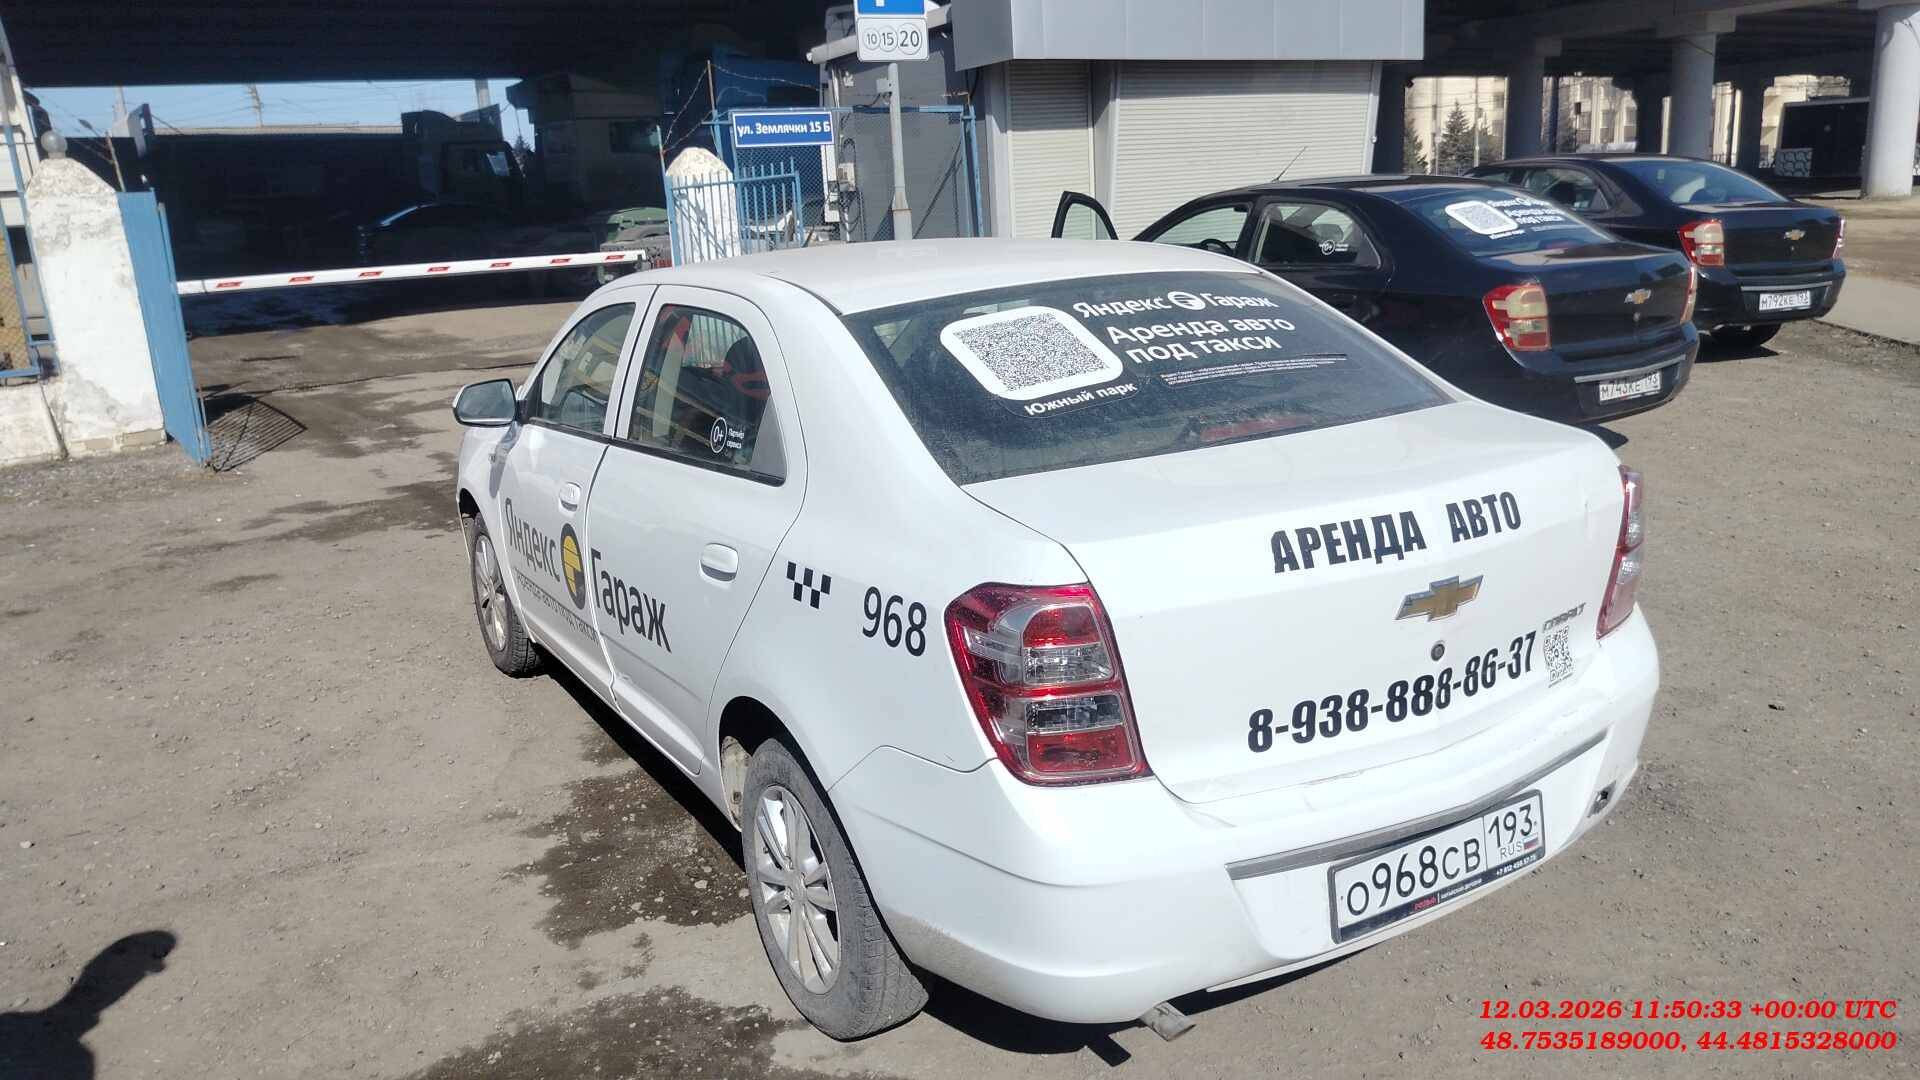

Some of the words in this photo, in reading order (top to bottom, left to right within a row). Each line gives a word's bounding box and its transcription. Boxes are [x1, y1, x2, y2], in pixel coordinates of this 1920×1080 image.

[866, 33, 877, 45] 10
[881, 32, 895, 46] 15
[900, 30, 920, 47] 20
[737, 125, 754, 138] ул.
[755, 122, 808, 134] Землячки
[809, 120, 822, 133] 15
[823, 121, 831, 132] Б
[1072, 296, 1172, 318] Яндекс
[1200, 293, 1280, 309] Гараж
[1106, 320, 1229, 345] Аренда
[1228, 318, 1296, 331] авто
[1125, 343, 1198, 363] под
[1190, 335, 1282, 354] такси
[1024, 390, 1095, 416] Южный
[1093, 382, 1138, 400] парк
[1270, 510, 1427, 574] АРЕНДА
[1445, 491, 1522, 543] АВТО
[505, 497, 561, 582] Яндекс
[591, 547, 672, 654] Гараж
[862, 586, 927, 657] 968
[1247, 630, 1537, 753] 8-938-888-86-37
[1488, 803, 1533, 848] 193
[1500, 840, 1524, 860] RUS
